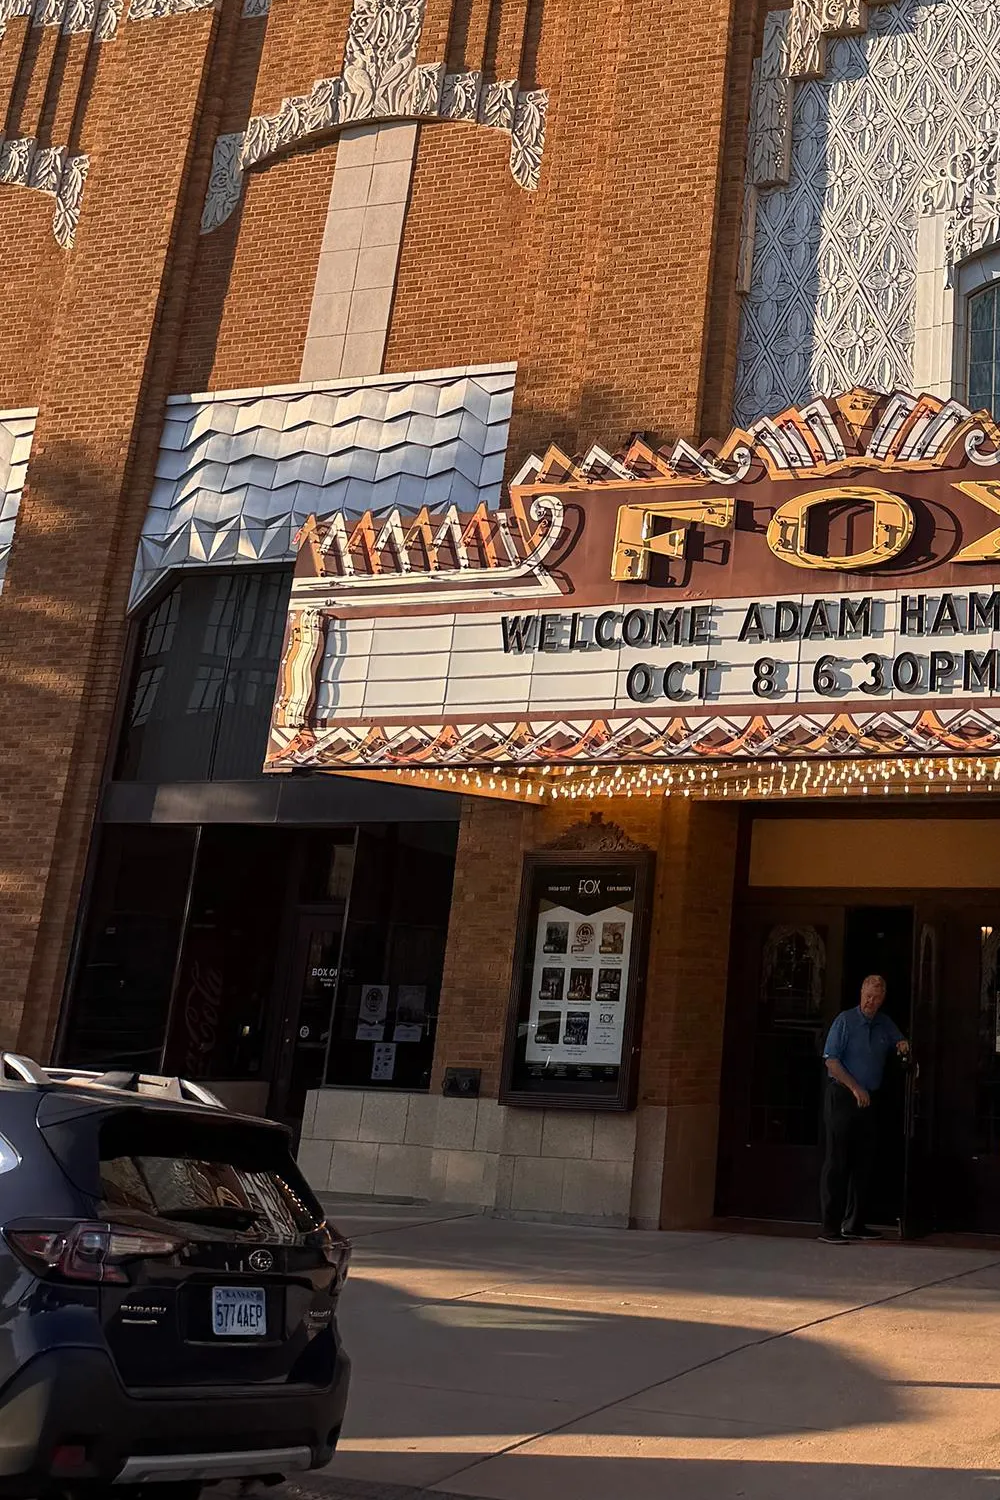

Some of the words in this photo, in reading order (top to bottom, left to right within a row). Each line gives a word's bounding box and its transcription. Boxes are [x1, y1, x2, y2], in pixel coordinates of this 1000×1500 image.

[501, 605, 712, 654] WELCOME
[737, 596, 873, 642] ADAM
[626, 659, 718, 702] OCT
[751, 656, 777, 699] 8
[578, 879, 601, 894] FOX
[311, 967, 328, 977] BOX
[215, 1303, 263, 1328] 5774AEP
